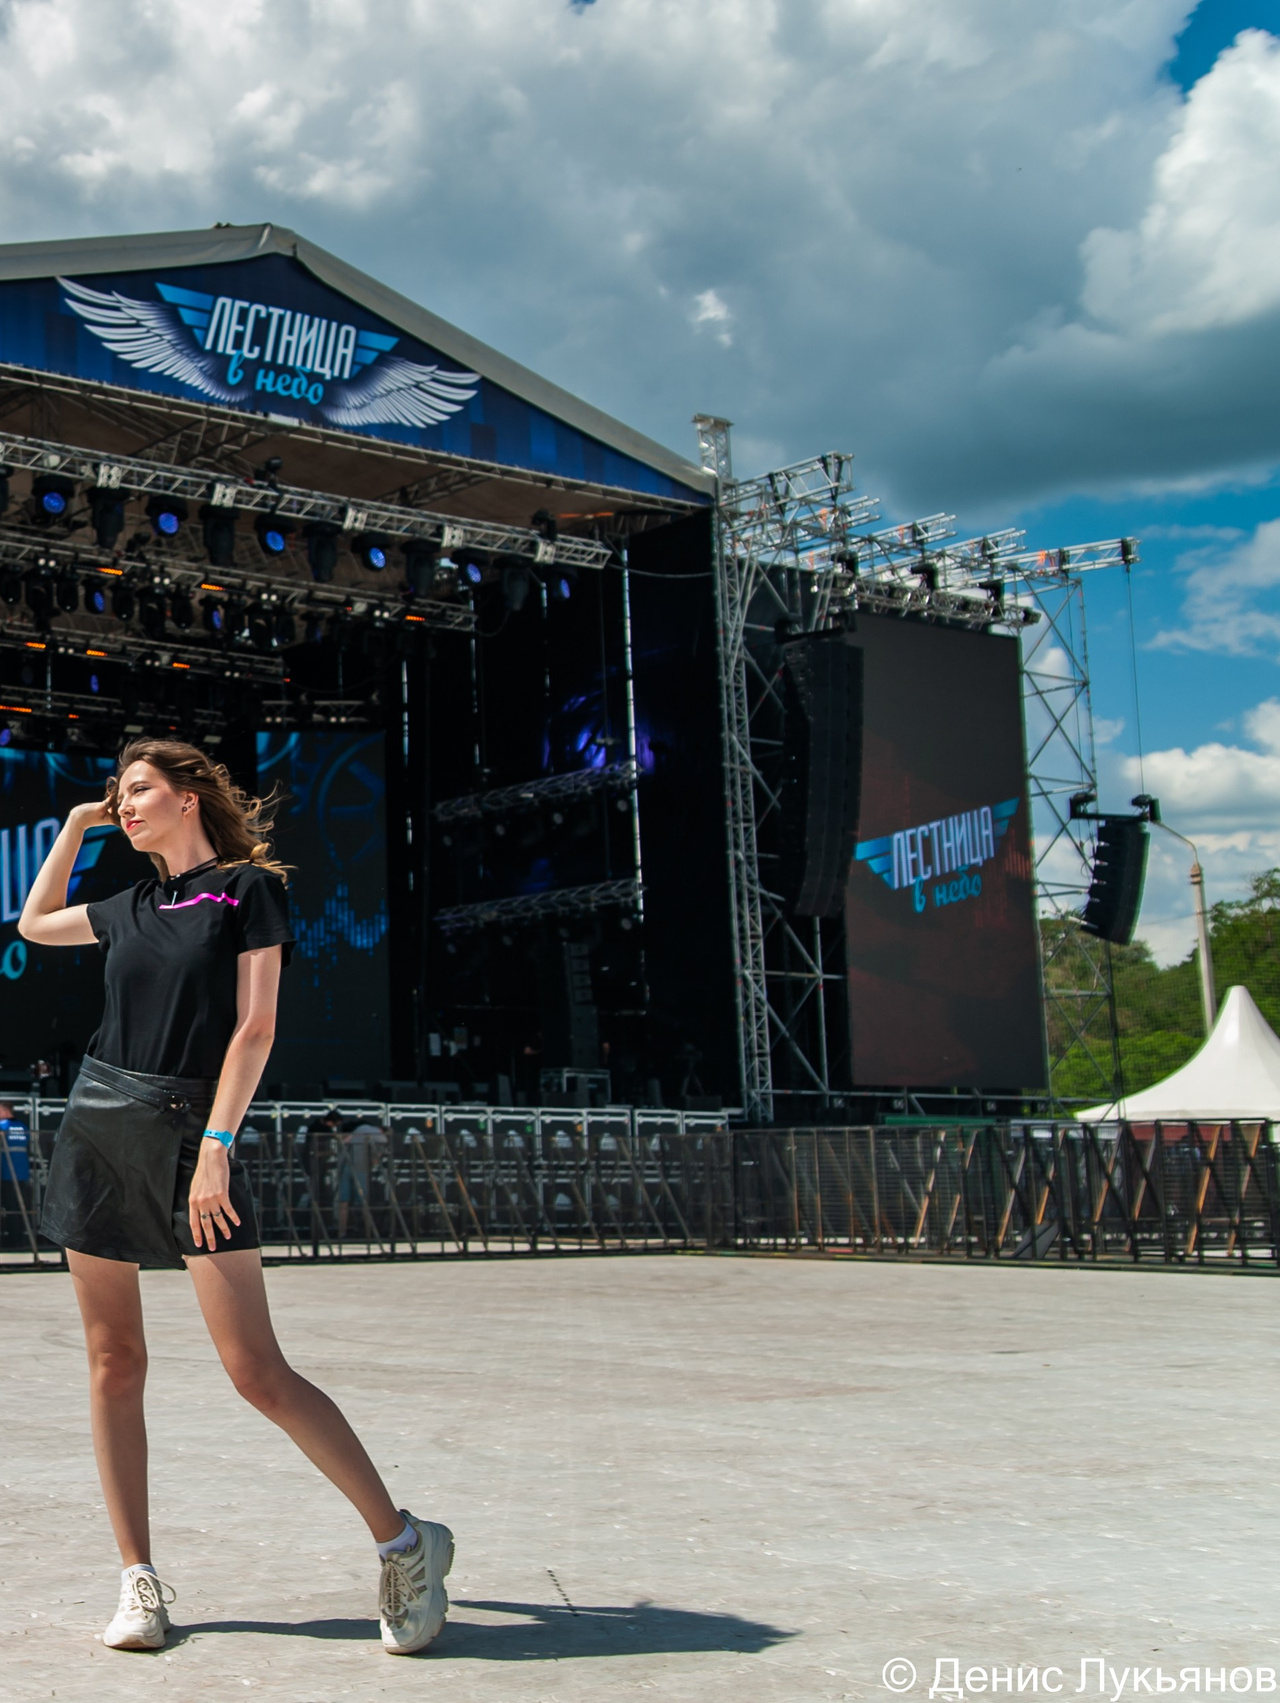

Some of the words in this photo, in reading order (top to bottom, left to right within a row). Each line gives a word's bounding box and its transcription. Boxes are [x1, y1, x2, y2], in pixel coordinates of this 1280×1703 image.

[204, 296, 357, 381] ЛЕСТНИЦА
[226, 350, 245, 386] в
[255, 366, 324, 405] небо
[892, 806, 995, 890] ЛЕСТНИЦА
[913, 876, 927, 913] в
[933, 865, 982, 907] небо
